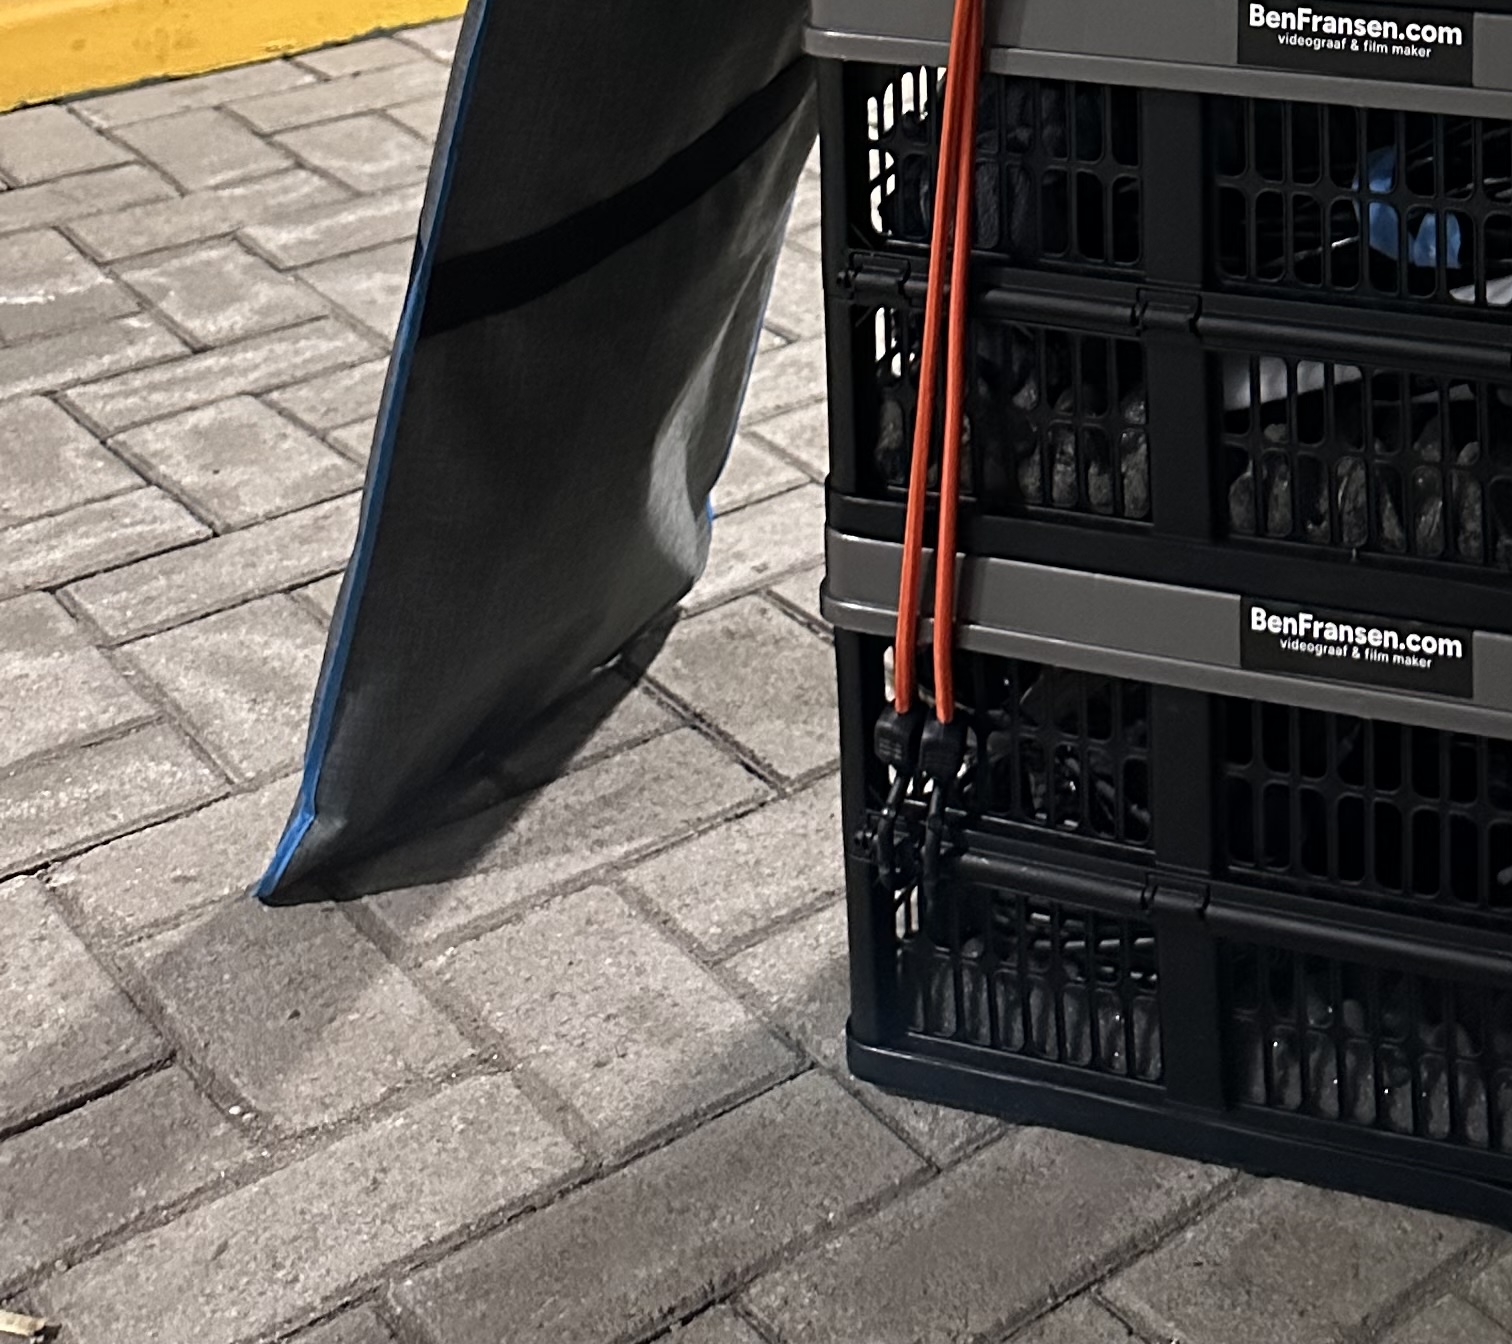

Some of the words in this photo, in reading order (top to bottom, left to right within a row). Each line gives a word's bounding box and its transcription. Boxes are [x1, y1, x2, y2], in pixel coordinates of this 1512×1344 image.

[1249, 3, 1463, 46] BenFransen.com
[1278, 32, 1347, 50] videograaf
[1350, 38, 1360, 52] &
[1363, 40, 1389, 54] film
[1391, 44, 1432, 58] maker
[1250, 606, 1463, 659] BenFransen.com
[1279, 637, 1348, 657] videograaf
[1351, 645, 1361, 660] &
[1364, 647, 1390, 663] film
[1392, 654, 1433, 668] maker
